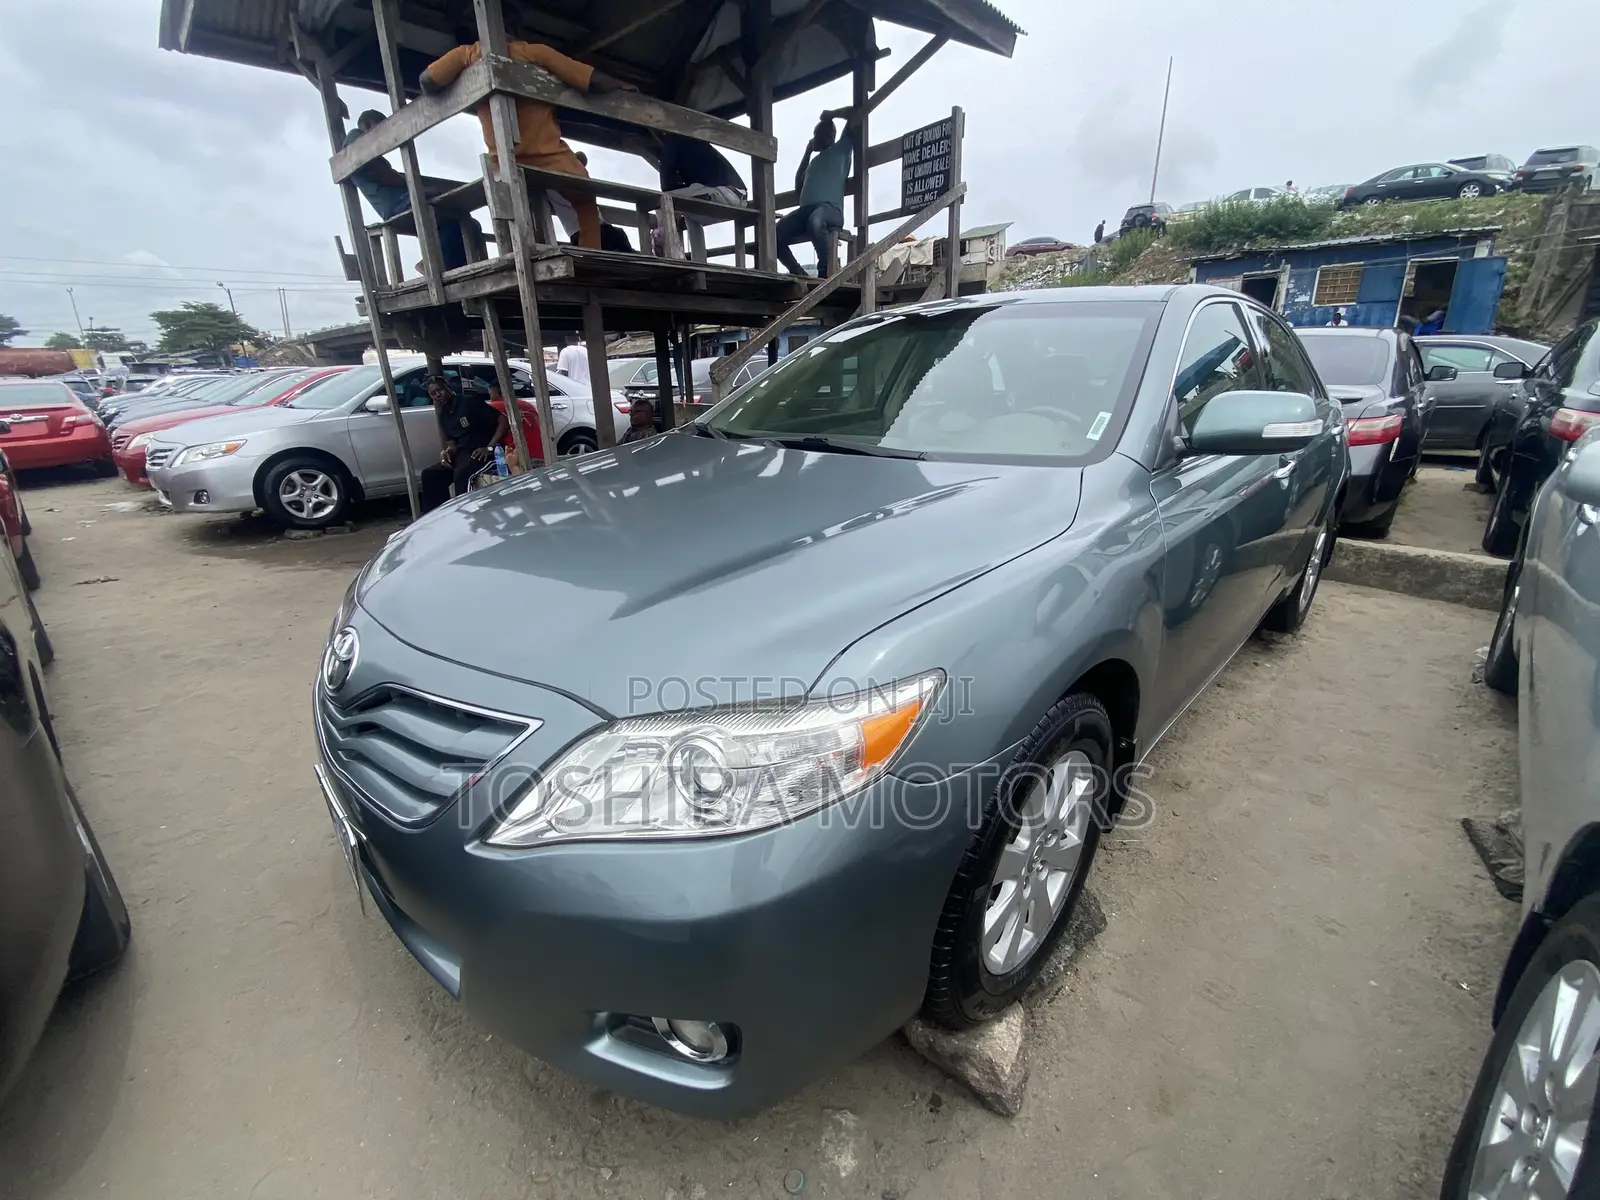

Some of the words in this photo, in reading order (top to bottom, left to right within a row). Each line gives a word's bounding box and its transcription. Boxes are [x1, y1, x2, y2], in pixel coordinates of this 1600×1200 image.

[904, 135, 914, 150] OUT
[915, 132, 922, 146] OF
[923, 126, 941, 144] BOUND
[904, 149, 920, 166] NONE
[907, 182, 913, 195] IS
[914, 174, 944, 193] ALLOWED
[924, 191, 938, 202] MGT
